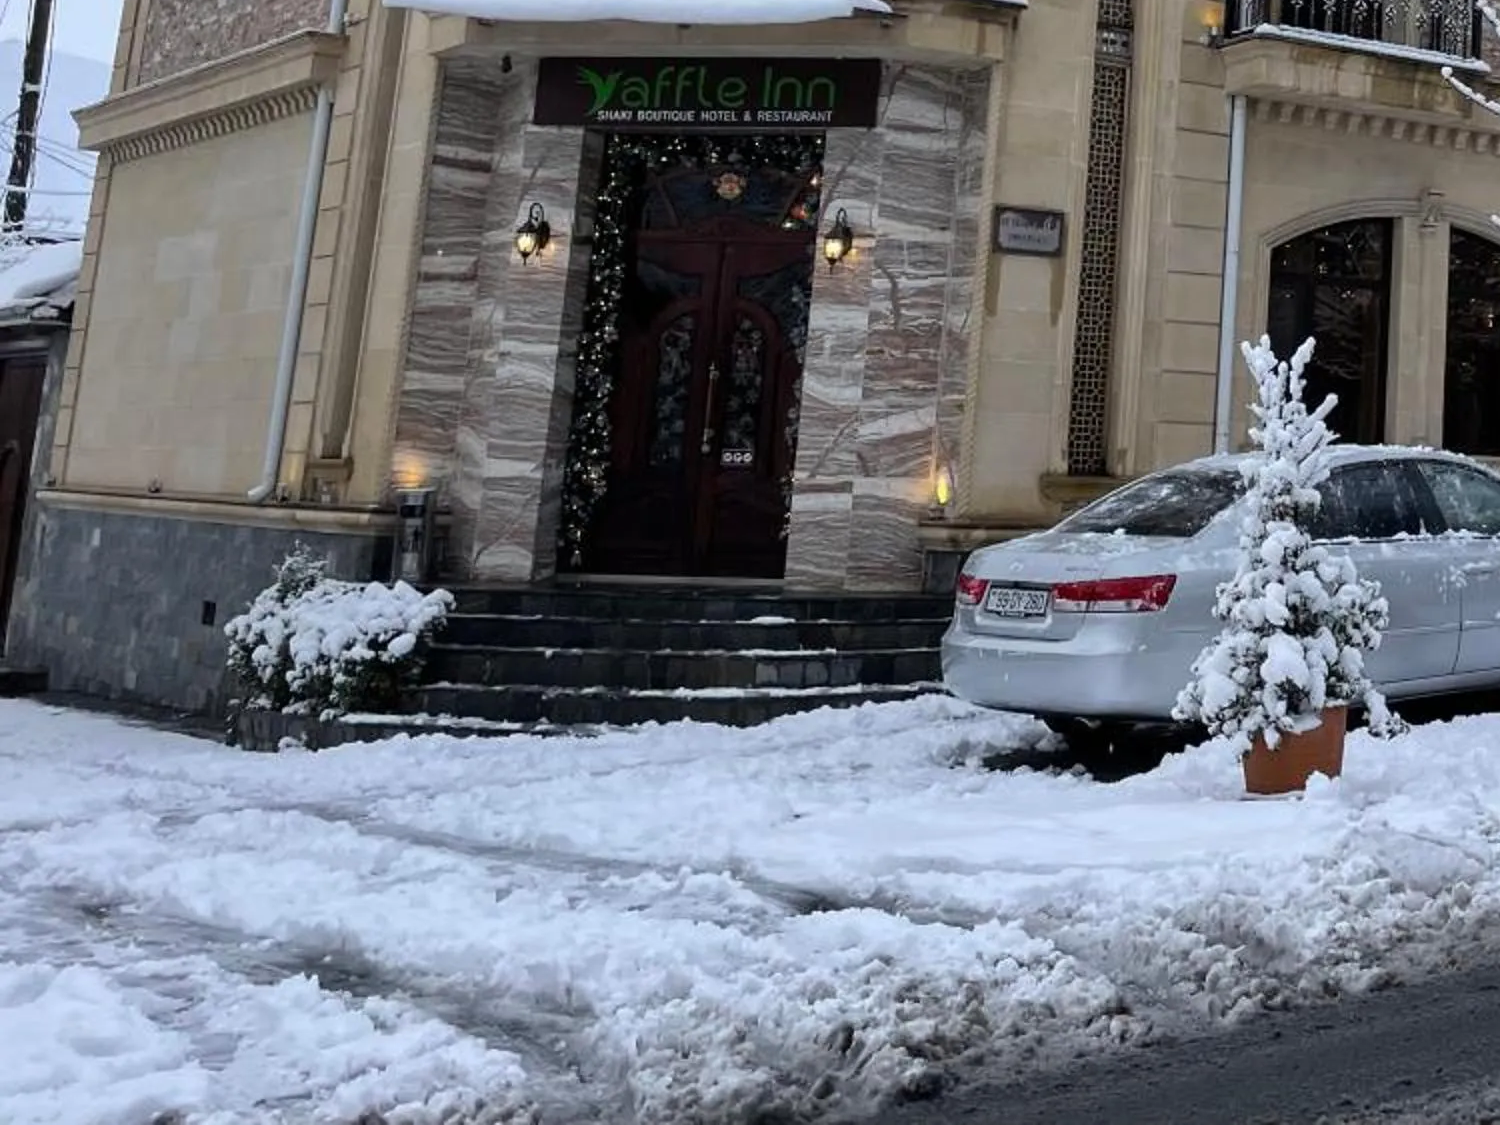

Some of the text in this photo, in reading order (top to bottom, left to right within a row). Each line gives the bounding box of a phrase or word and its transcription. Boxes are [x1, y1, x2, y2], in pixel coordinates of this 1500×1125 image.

[763, 66, 836, 108] Inn
[637, 110, 695, 122] BOUTIQUE
[701, 110, 738, 122] HOTEL
[743, 110, 752, 122] &
[757, 110, 833, 122] RESTAURANT
